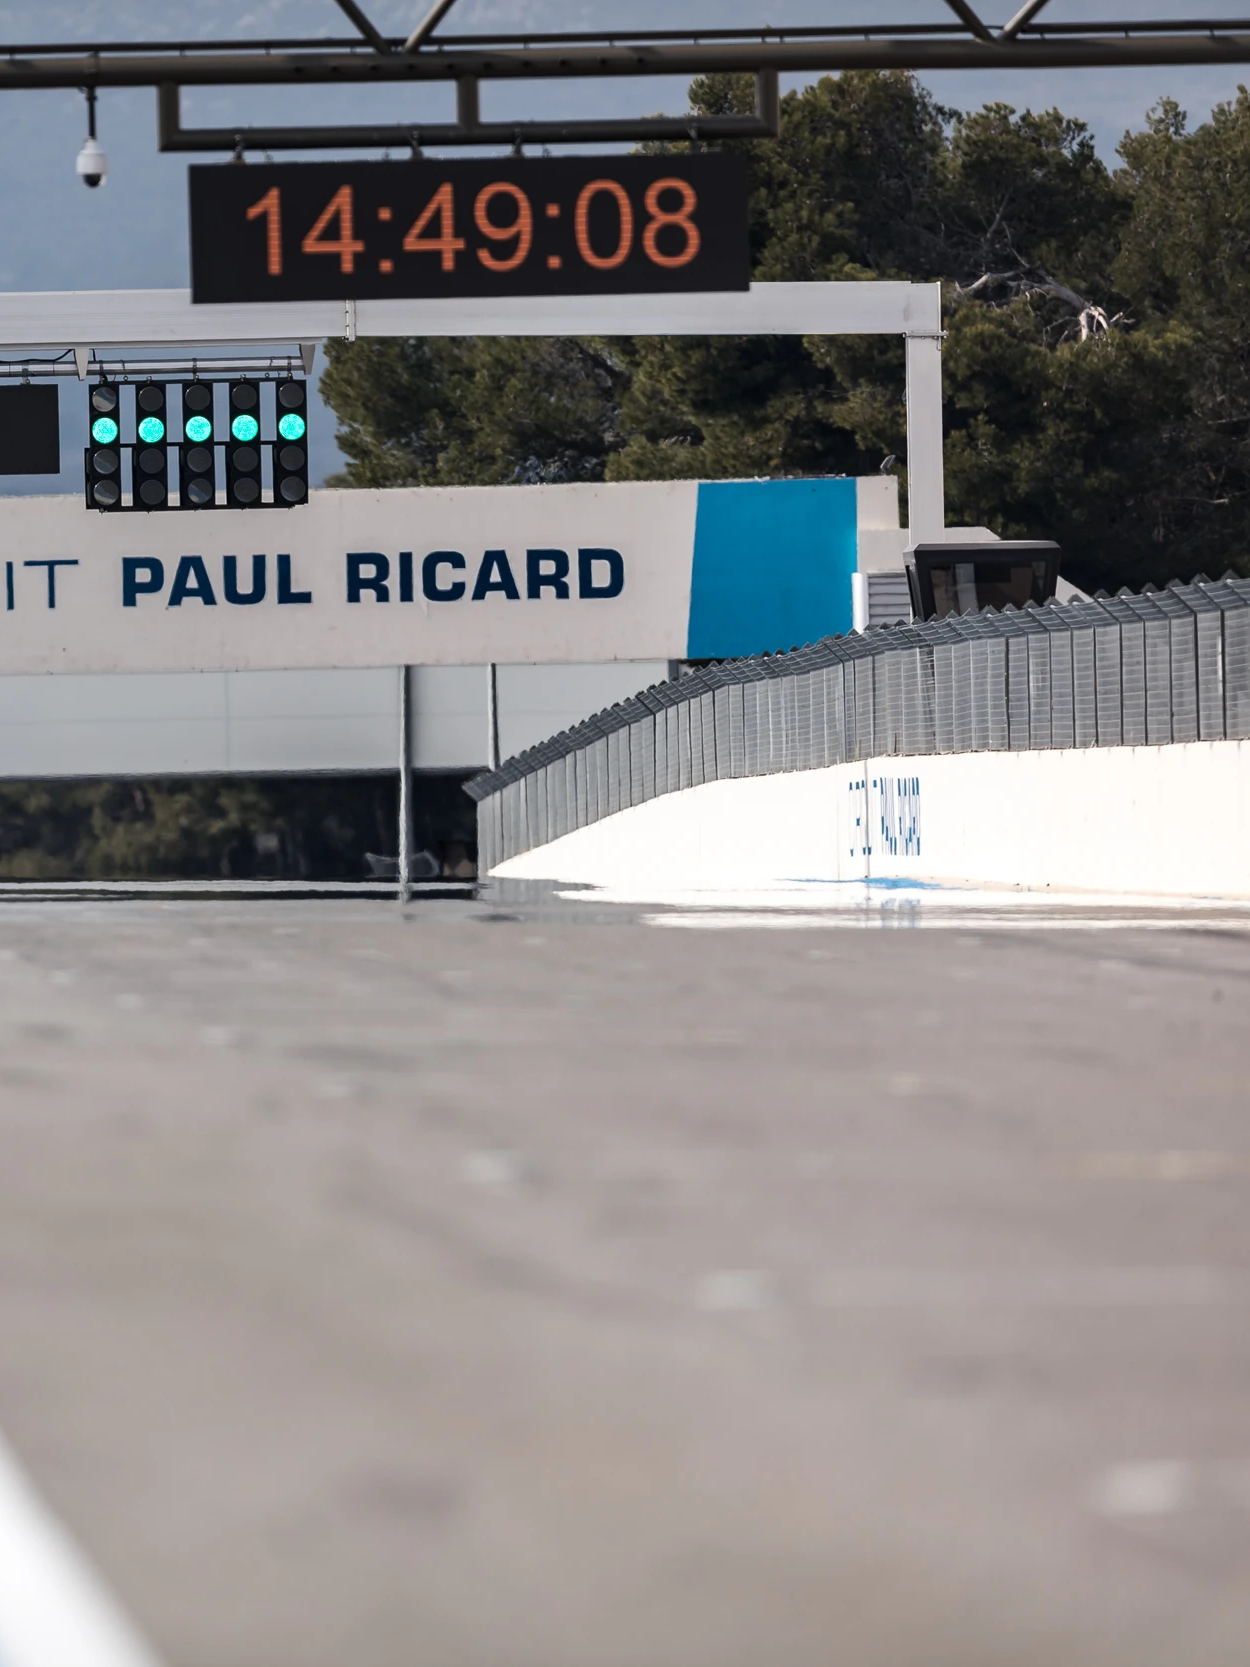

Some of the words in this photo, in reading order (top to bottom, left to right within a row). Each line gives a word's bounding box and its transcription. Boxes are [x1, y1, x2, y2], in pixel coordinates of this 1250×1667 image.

[245, 176, 701, 276] 14:49:08
[121, 553, 313, 608] PAUL
[345, 547, 625, 604] RICARD
